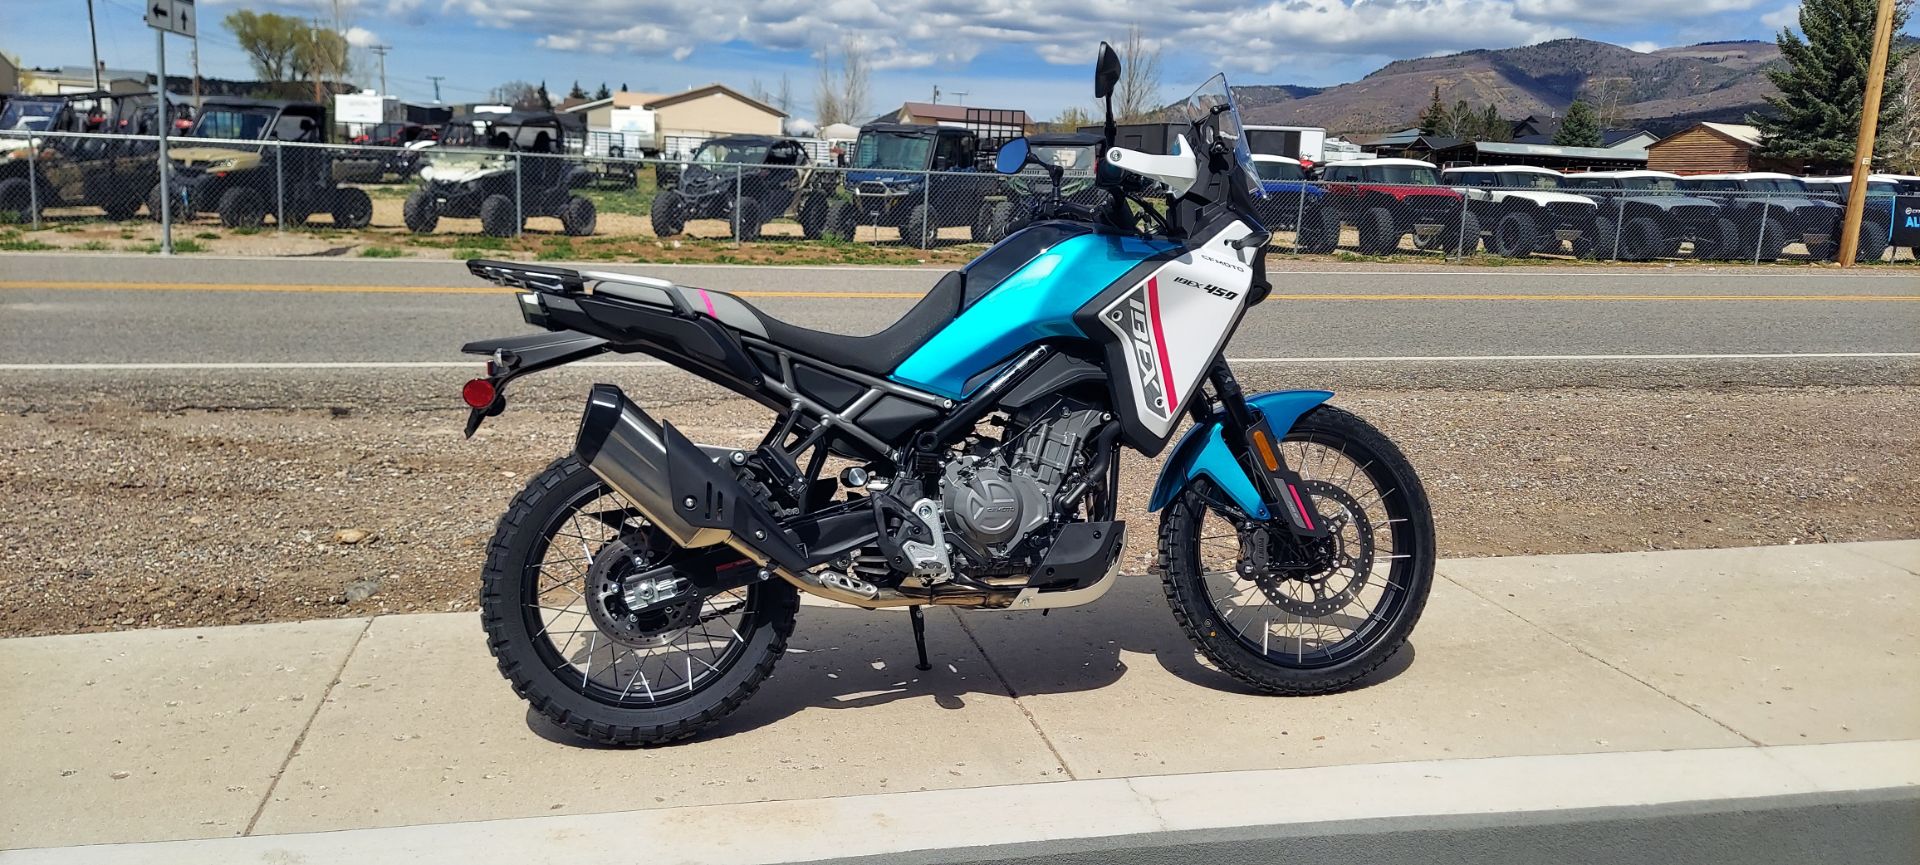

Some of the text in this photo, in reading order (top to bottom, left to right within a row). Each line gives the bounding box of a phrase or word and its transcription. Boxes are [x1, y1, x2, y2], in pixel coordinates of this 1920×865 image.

[1201, 254, 1244, 273] CFMOTO
[1173, 276, 1239, 300] IBEX 450
[1129, 298, 1160, 394] IBEX
